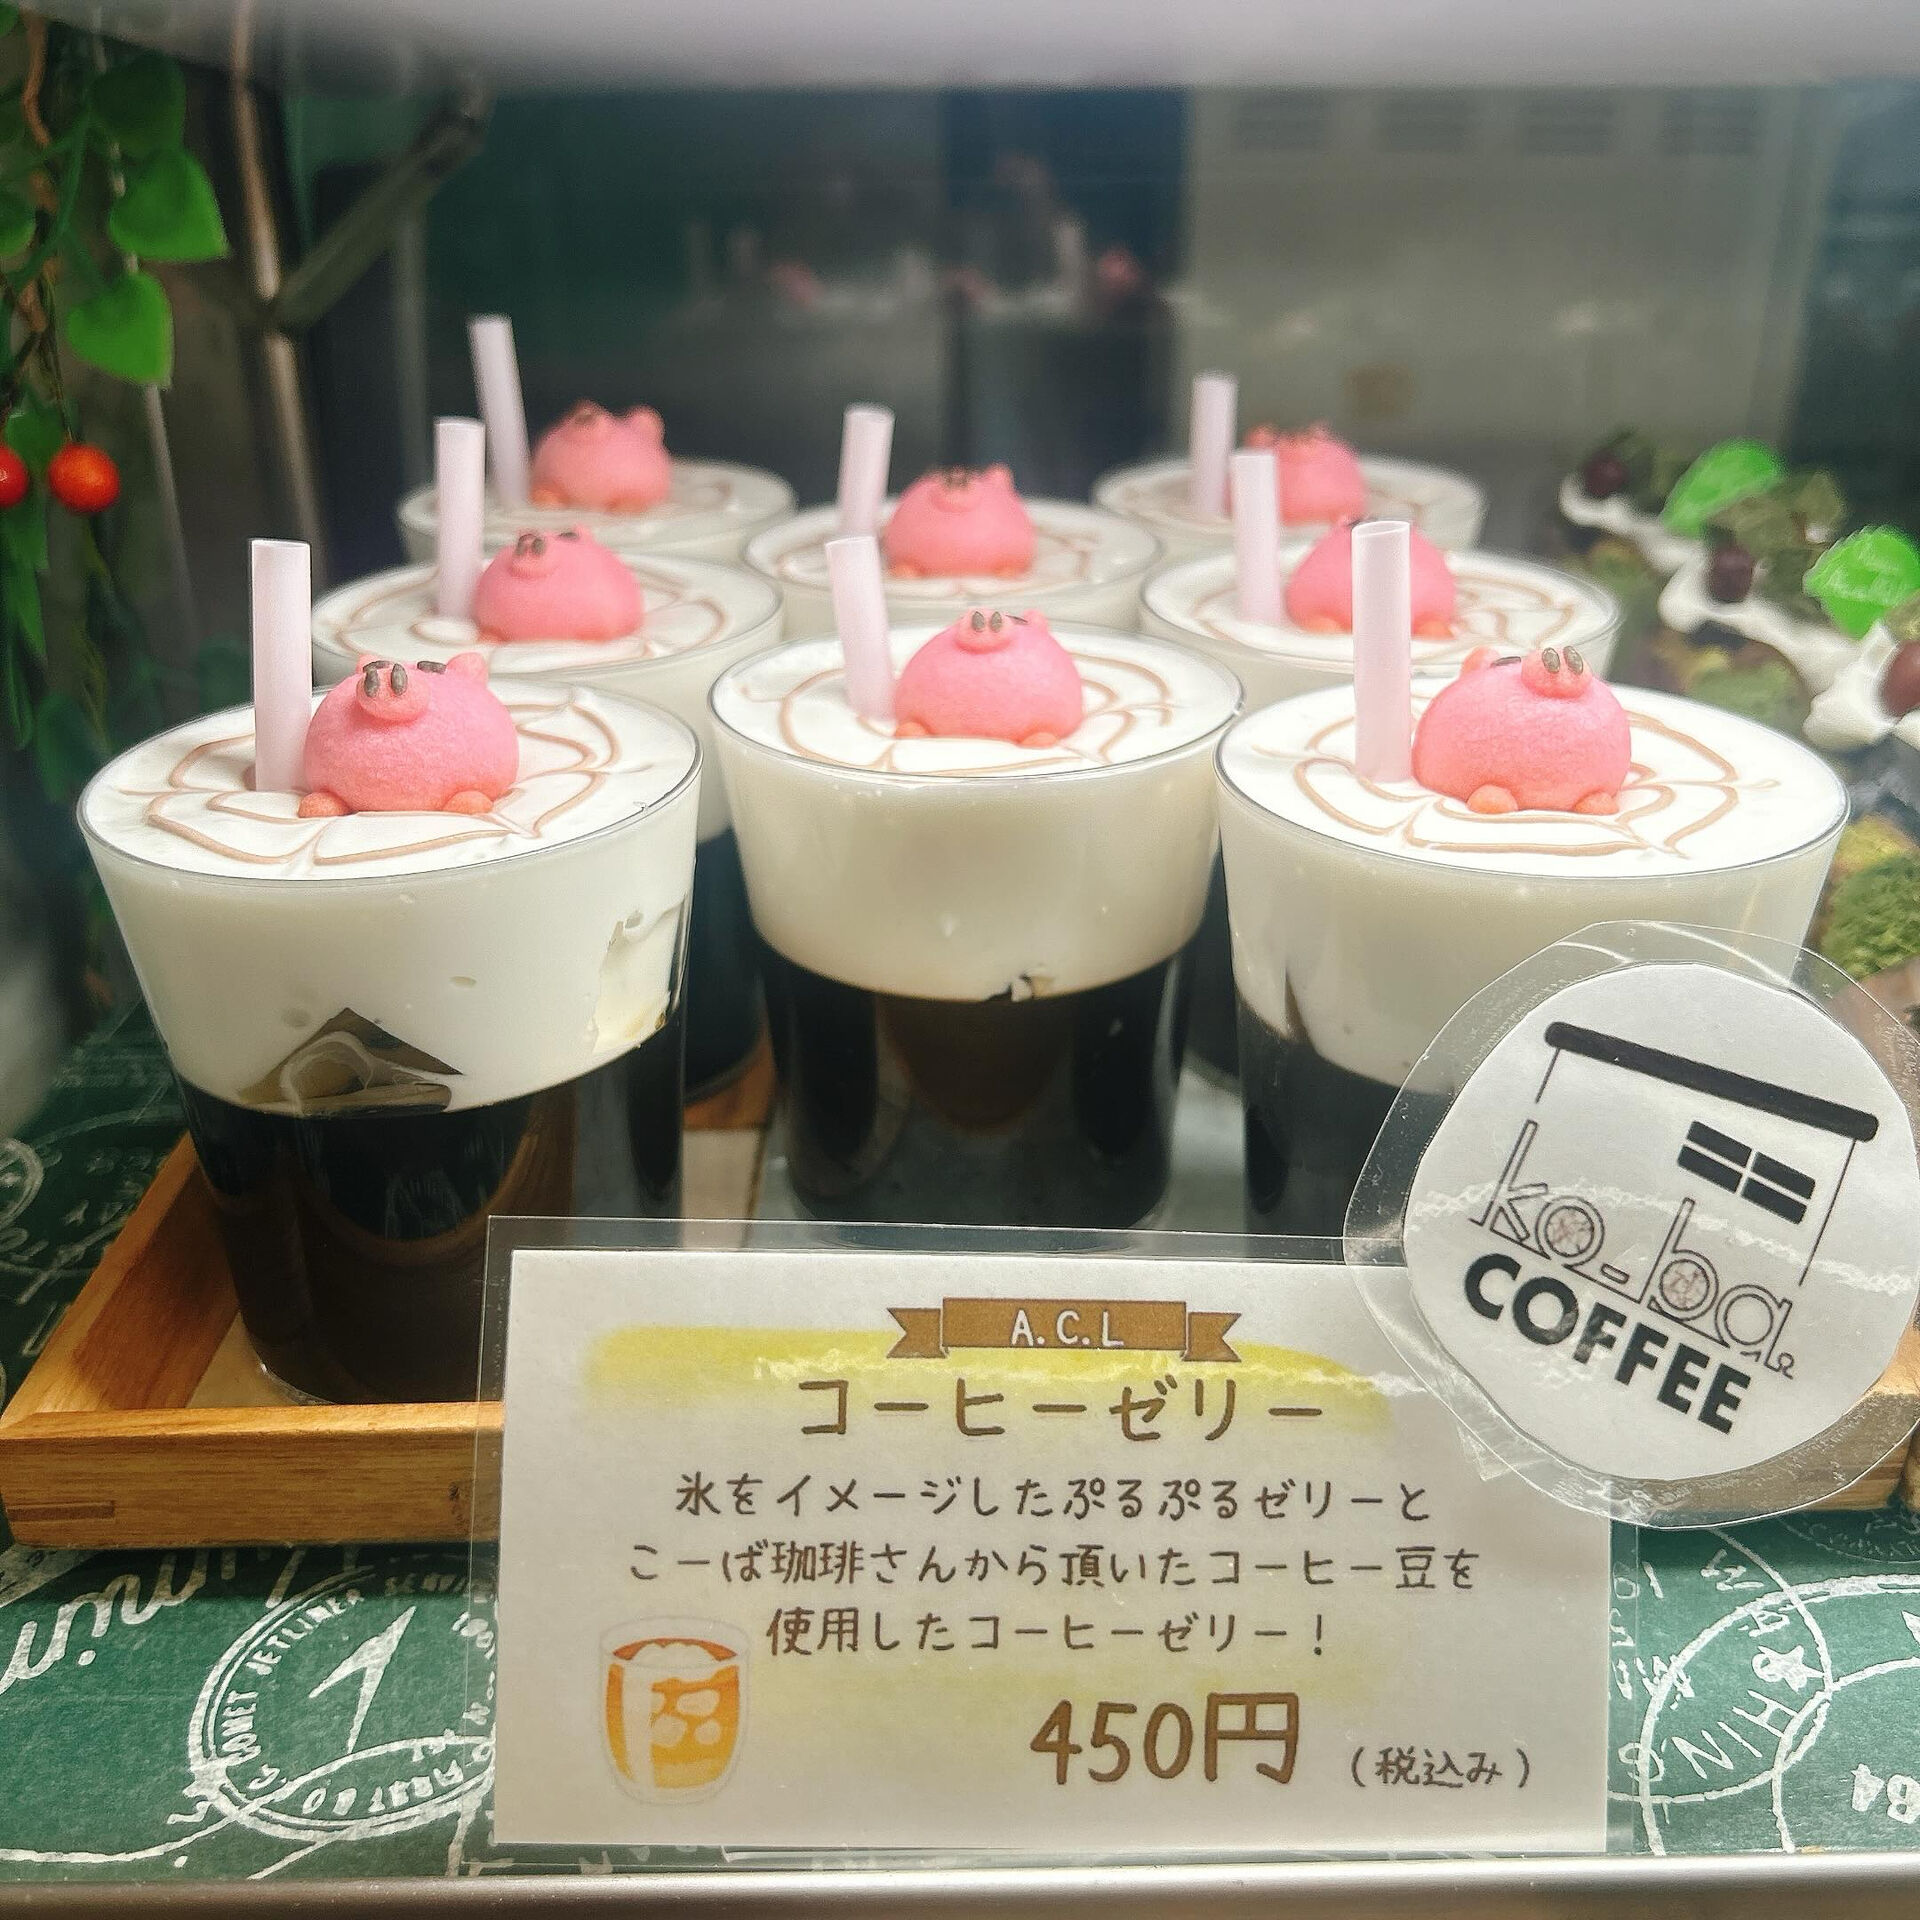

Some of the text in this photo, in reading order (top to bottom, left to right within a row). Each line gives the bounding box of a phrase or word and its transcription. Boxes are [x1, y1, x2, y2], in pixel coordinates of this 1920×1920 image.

[1011, 1309, 1124, 1347] A.C.L
[1464, 1252, 1752, 1435] COFFEE
[798, 1374, 1323, 1442] コーヒーゼリー
[675, 1470, 1430, 1522] 氷をイメージしたぷるぷるゼリーと
[629, 1538, 1480, 1590] こーば珈琲さんから頂いたコーヒー豆を
[766, 1606, 1323, 1656] 使用したコーヒーゼリー！
[1029, 1691, 1300, 1786] 450円
